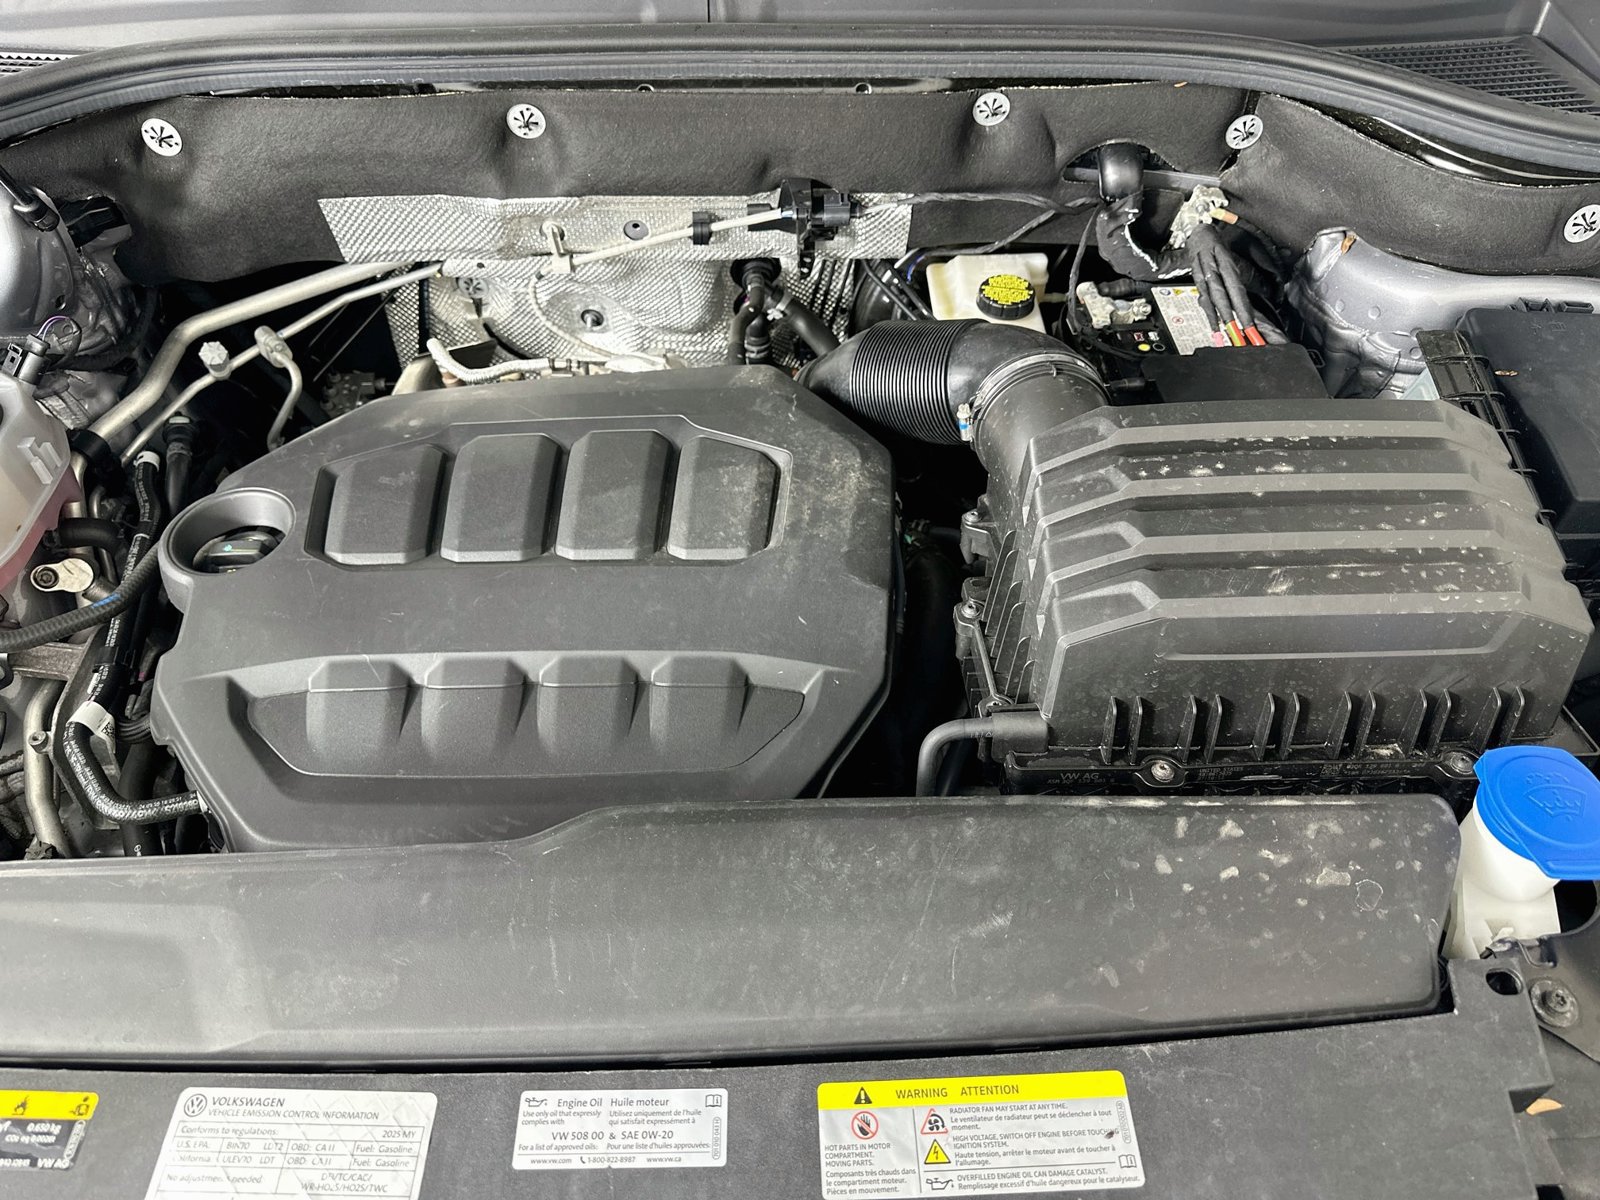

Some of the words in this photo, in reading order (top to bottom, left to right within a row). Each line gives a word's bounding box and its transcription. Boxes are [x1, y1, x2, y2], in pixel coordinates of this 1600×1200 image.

[896, 1088, 948, 1099] WARNING
[960, 1085, 1019, 1096] ATTENTION
[212, 1096, 285, 1107] VOLKSWAGEN
[558, 1098, 587, 1109] Engine
[590, 1098, 602, 1106] Oil
[610, 1098, 634, 1106] Huile
[636, 1098, 669, 1106] moteur
[242, 1109, 280, 1117] EMISSION
[283, 1110, 319, 1118] CONTROL
[322, 1110, 379, 1119] INFORMATION
[536, 1110, 549, 1118] only
[573, 1110, 601, 1118] expressly
[634, 1110, 672, 1118] uniquement
[950, 1106, 980, 1114] RADIATOR
[960, 1114, 993, 1122] ventilateur
[1004, 1112, 1032, 1120] radiateur
[608, 1118, 619, 1126] qui
[646, 1118, 690, 1126] expressément
[181, 1125, 219, 1134] Conforms
[382, 1130, 401, 1138] 2025
[552, 1132, 569, 1140] VW
[571, 1131, 588, 1140] 508
[591, 1131, 604, 1140] 00
[609, 1132, 616, 1140] &
[621, 1131, 639, 1139] SAE
[642, 1130, 673, 1139] 0W-20
[291, 1143, 311, 1151] OBD:
[356, 1145, 375, 1153] Fuel:
[554, 1143, 583, 1152] approved
[38, 1158, 54, 1168] VW
[223, 1155, 252, 1163] ULEV70
[260, 1156, 275, 1164] LDT
[375, 1159, 410, 1167] Gasoline
[826, 1170, 864, 1179] Composants
[957, 1173, 995, 1181] OVERFILLED
[834, 1179, 880, 1188] compartiment
